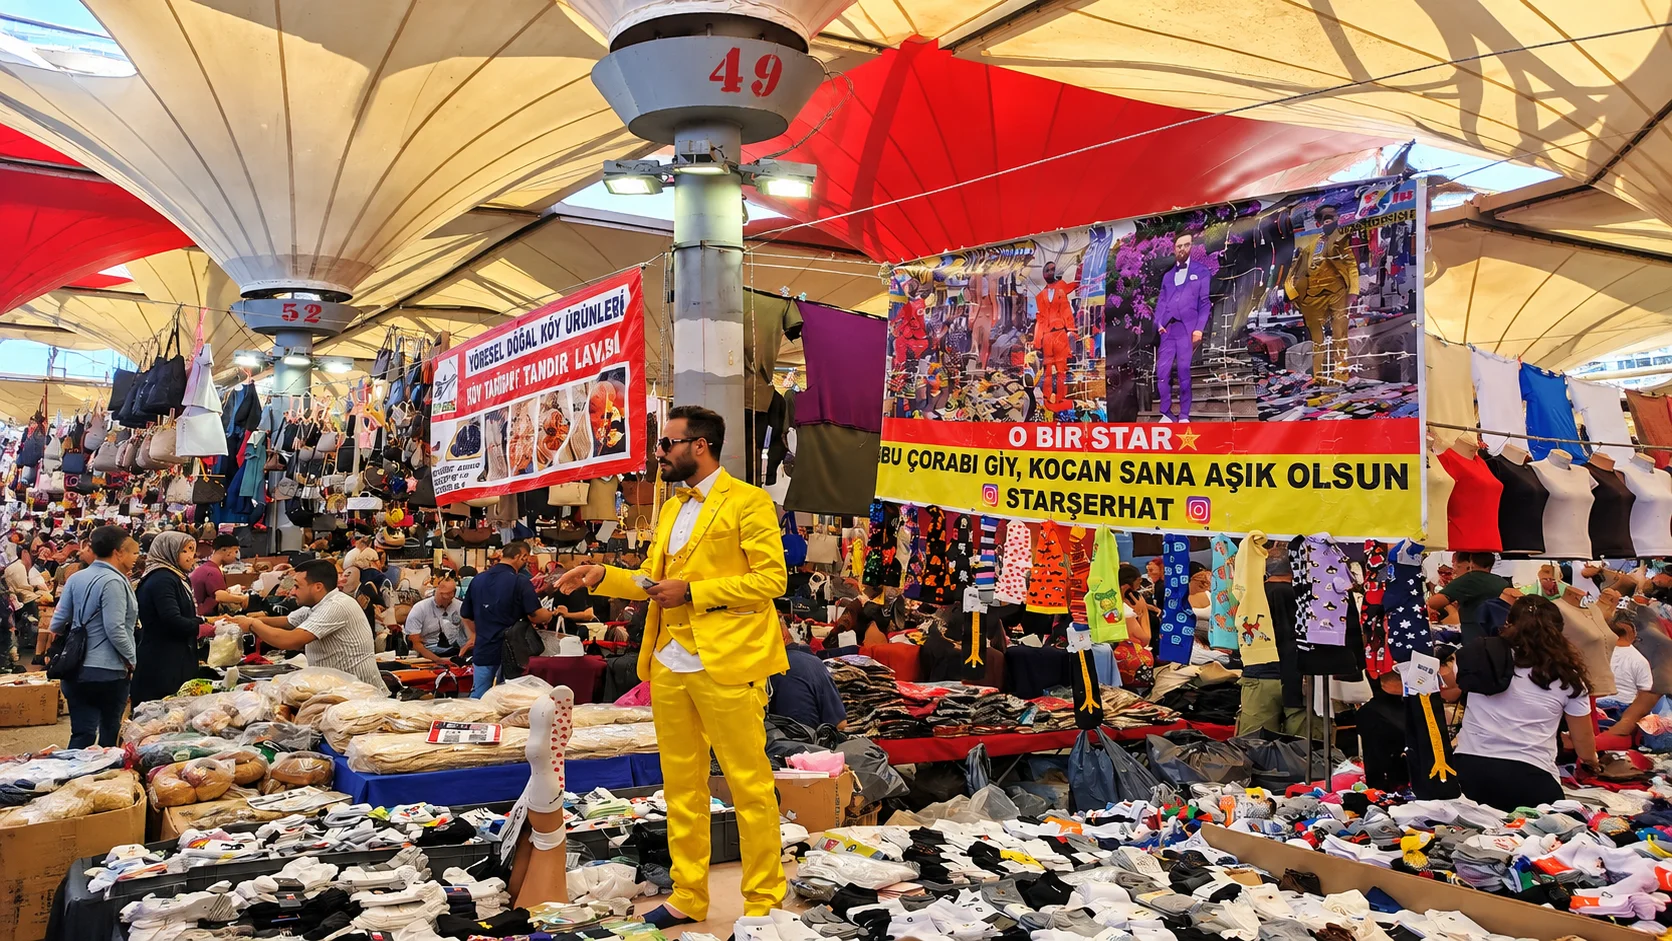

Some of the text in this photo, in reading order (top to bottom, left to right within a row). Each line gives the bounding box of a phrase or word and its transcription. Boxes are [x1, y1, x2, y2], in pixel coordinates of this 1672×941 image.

[709, 47, 783, 97] 49
[281, 303, 322, 323] 52
[541, 315, 562, 344] KÖY
[523, 351, 569, 386] TANDIR
[1008, 422, 1173, 450] O BİR STAR
[907, 449, 978, 474] ÇORABI
[984, 450, 1021, 482] GİY,
[1029, 457, 1111, 483] KOCAN
[1119, 461, 1196, 486] SANA
[1204, 462, 1277, 493] AŞIK
[1287, 462, 1409, 490] OLSUN
[1006, 487, 1175, 520] STARŞERHAT
